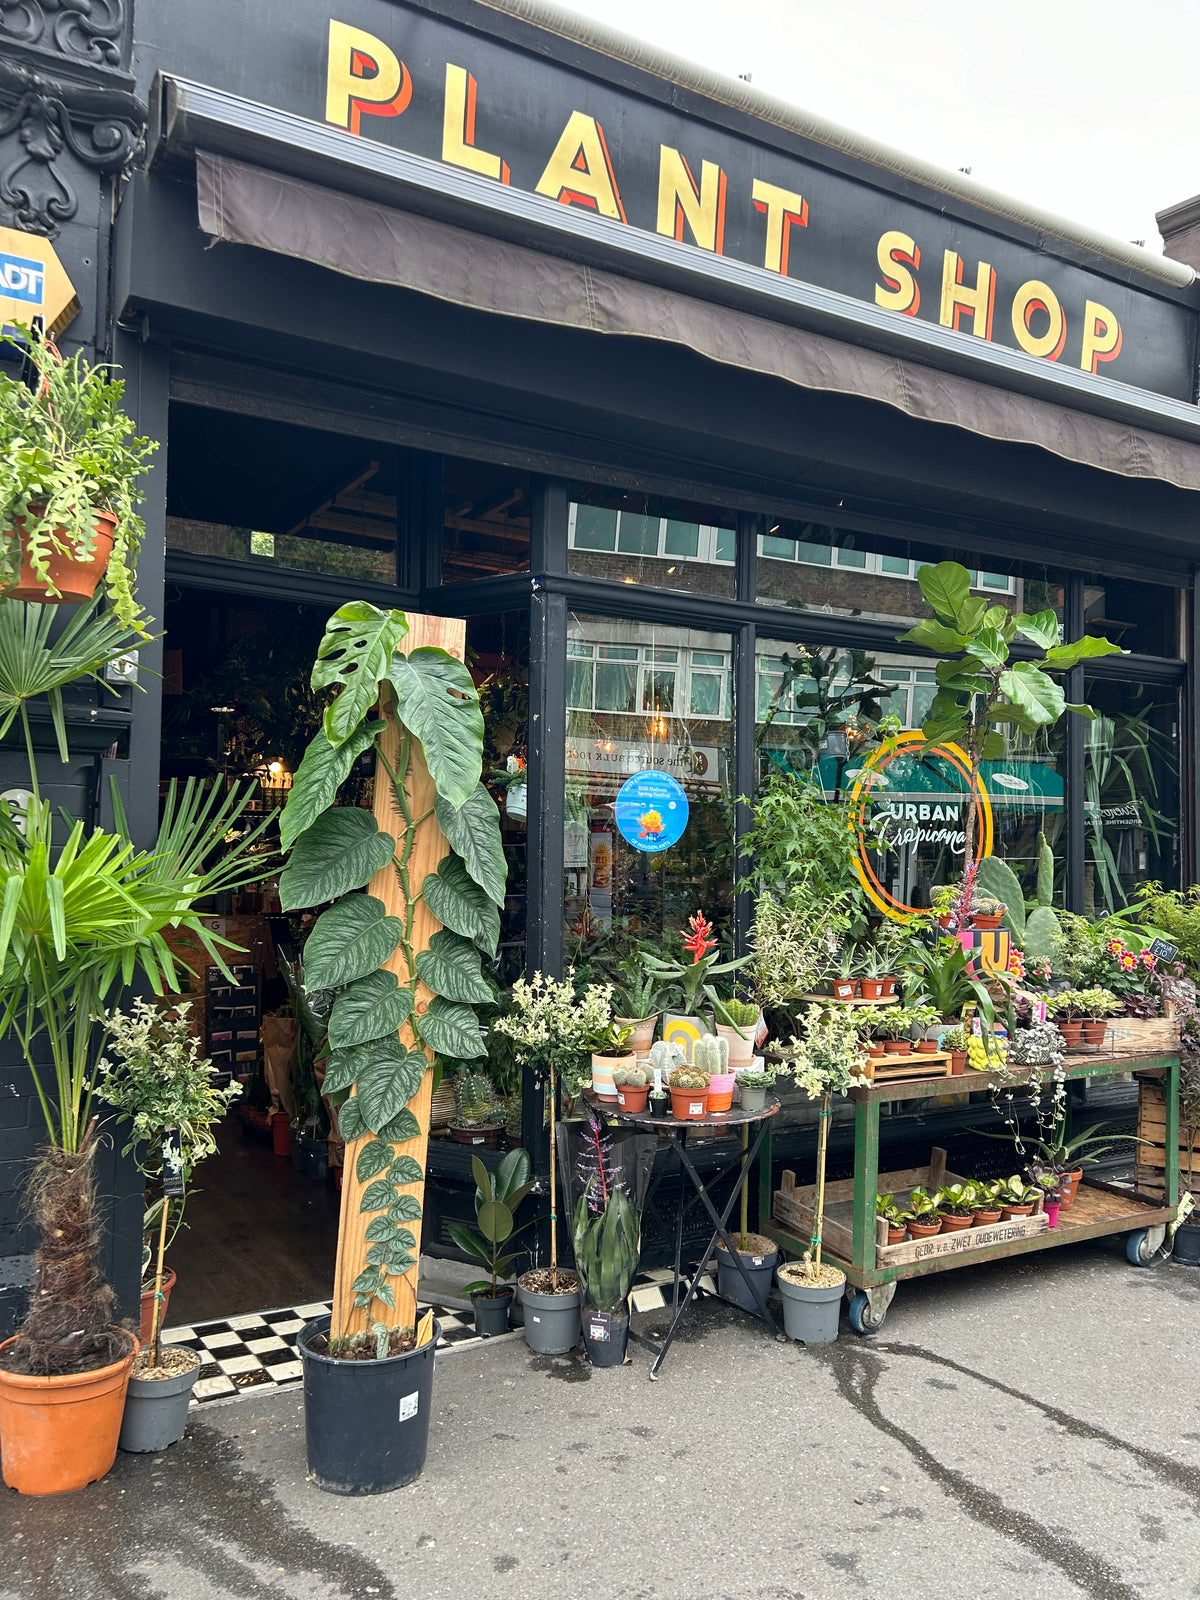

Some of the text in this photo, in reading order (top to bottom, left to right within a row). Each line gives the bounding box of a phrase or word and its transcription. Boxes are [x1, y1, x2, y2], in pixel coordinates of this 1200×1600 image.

[325, 18, 1123, 374] PLANT SHOP
[890, 803, 959, 824] URBAN
[869, 811, 967, 857] Tropicana
[951, 1235, 972, 1250] ZWET
[975, 1225, 1026, 1245] OUDEWETERING
